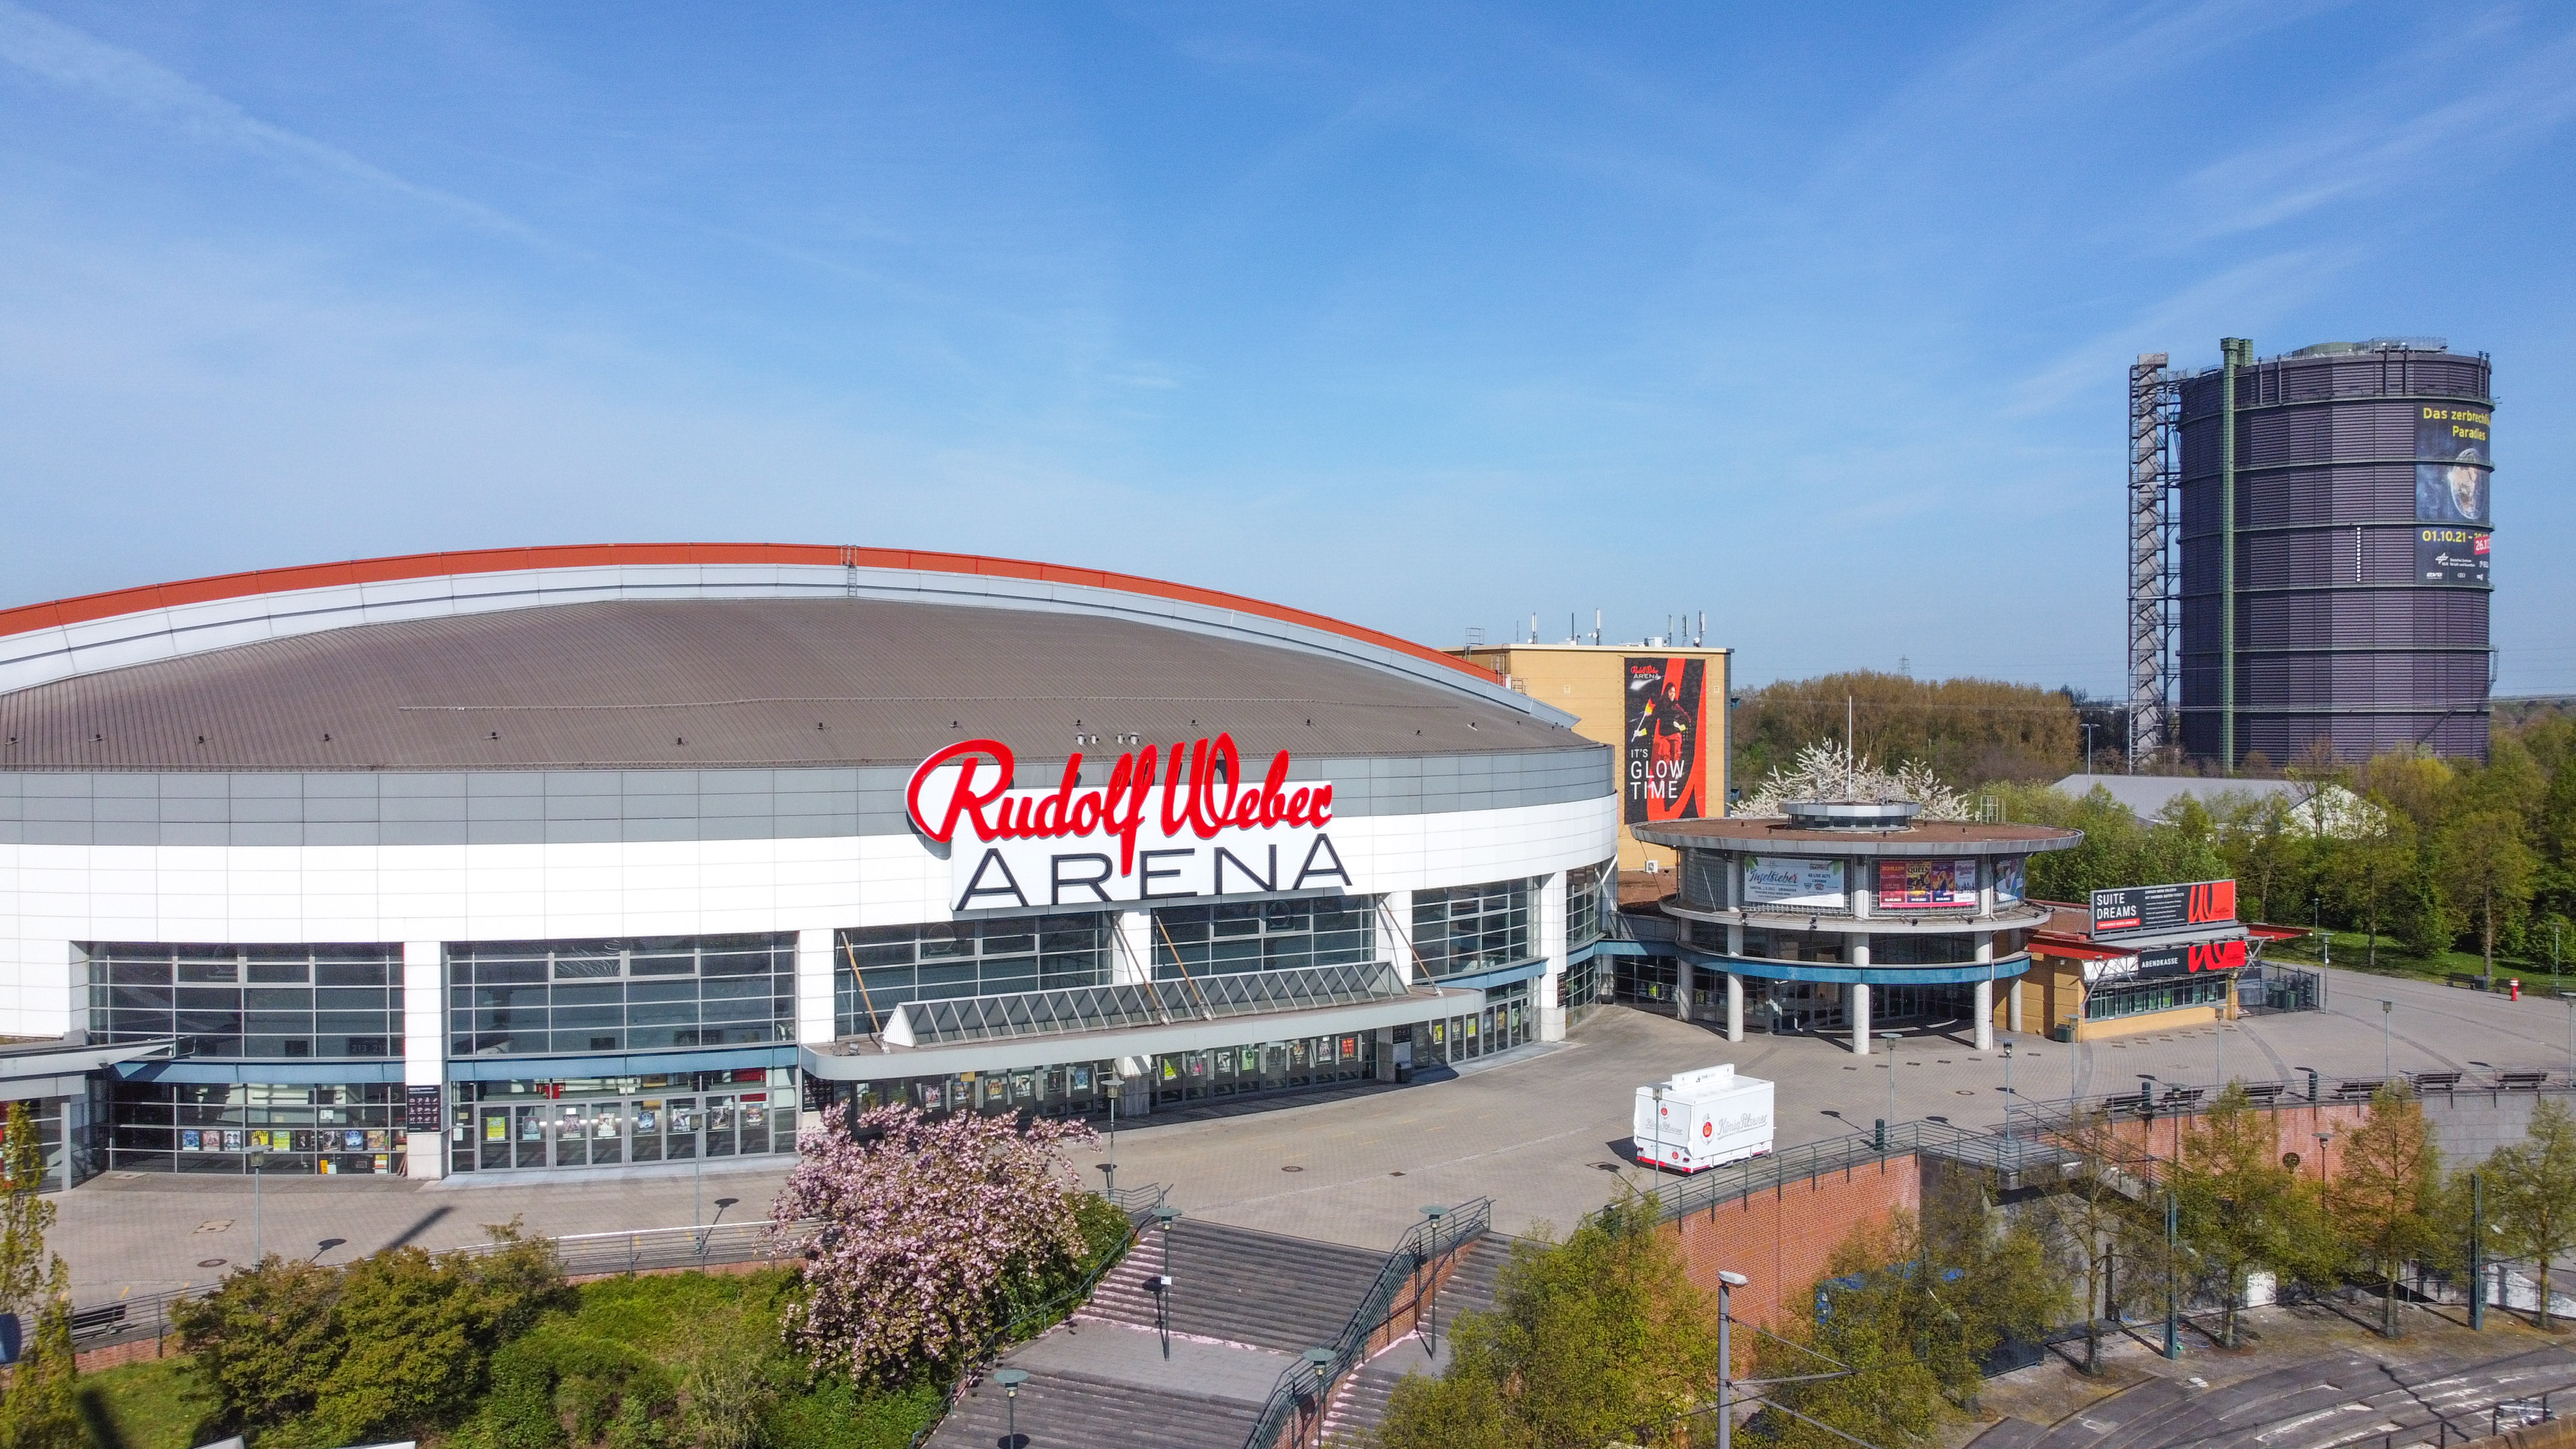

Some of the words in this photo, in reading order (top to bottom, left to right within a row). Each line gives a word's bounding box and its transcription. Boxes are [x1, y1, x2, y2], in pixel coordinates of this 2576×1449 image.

[2423, 407, 2447, 419] Das
[2453, 425, 2486, 441] Paradies
[2423, 530, 2466, 543] 01.10.21
[1631, 760, 1684, 779] GLOW
[1630, 781, 1677, 800] TIME
[906, 739, 1156, 876] Rudolf
[1160, 732, 1332, 839] Weber
[957, 833, 1352, 910] ARENA
[2097, 893, 2125, 906] SUITE
[2097, 905, 2136, 919] DREAMS
[2141, 957, 2179, 969] ABENDKASSE
